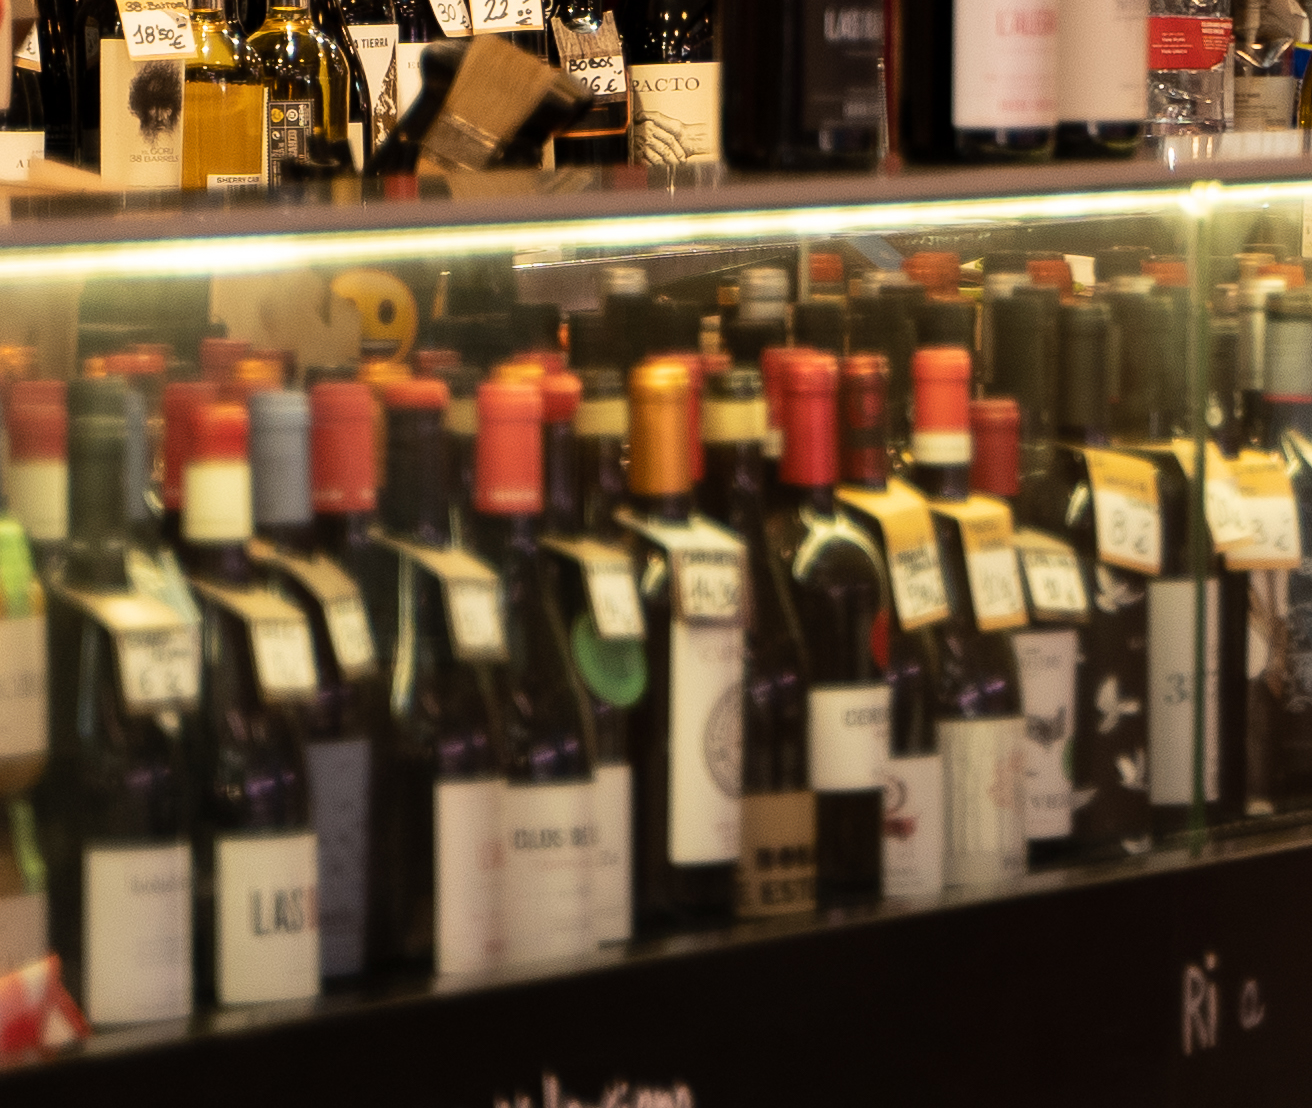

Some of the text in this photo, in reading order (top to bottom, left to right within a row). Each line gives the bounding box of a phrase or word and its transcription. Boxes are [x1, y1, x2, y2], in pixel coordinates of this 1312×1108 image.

[437, 3, 456, 22] 30
[132, 24, 174, 45] 18'50
[362, 38, 389, 49] TIERRA
[569, 57, 613, 72] BOBOS
[631, 77, 700, 92] PACTO
